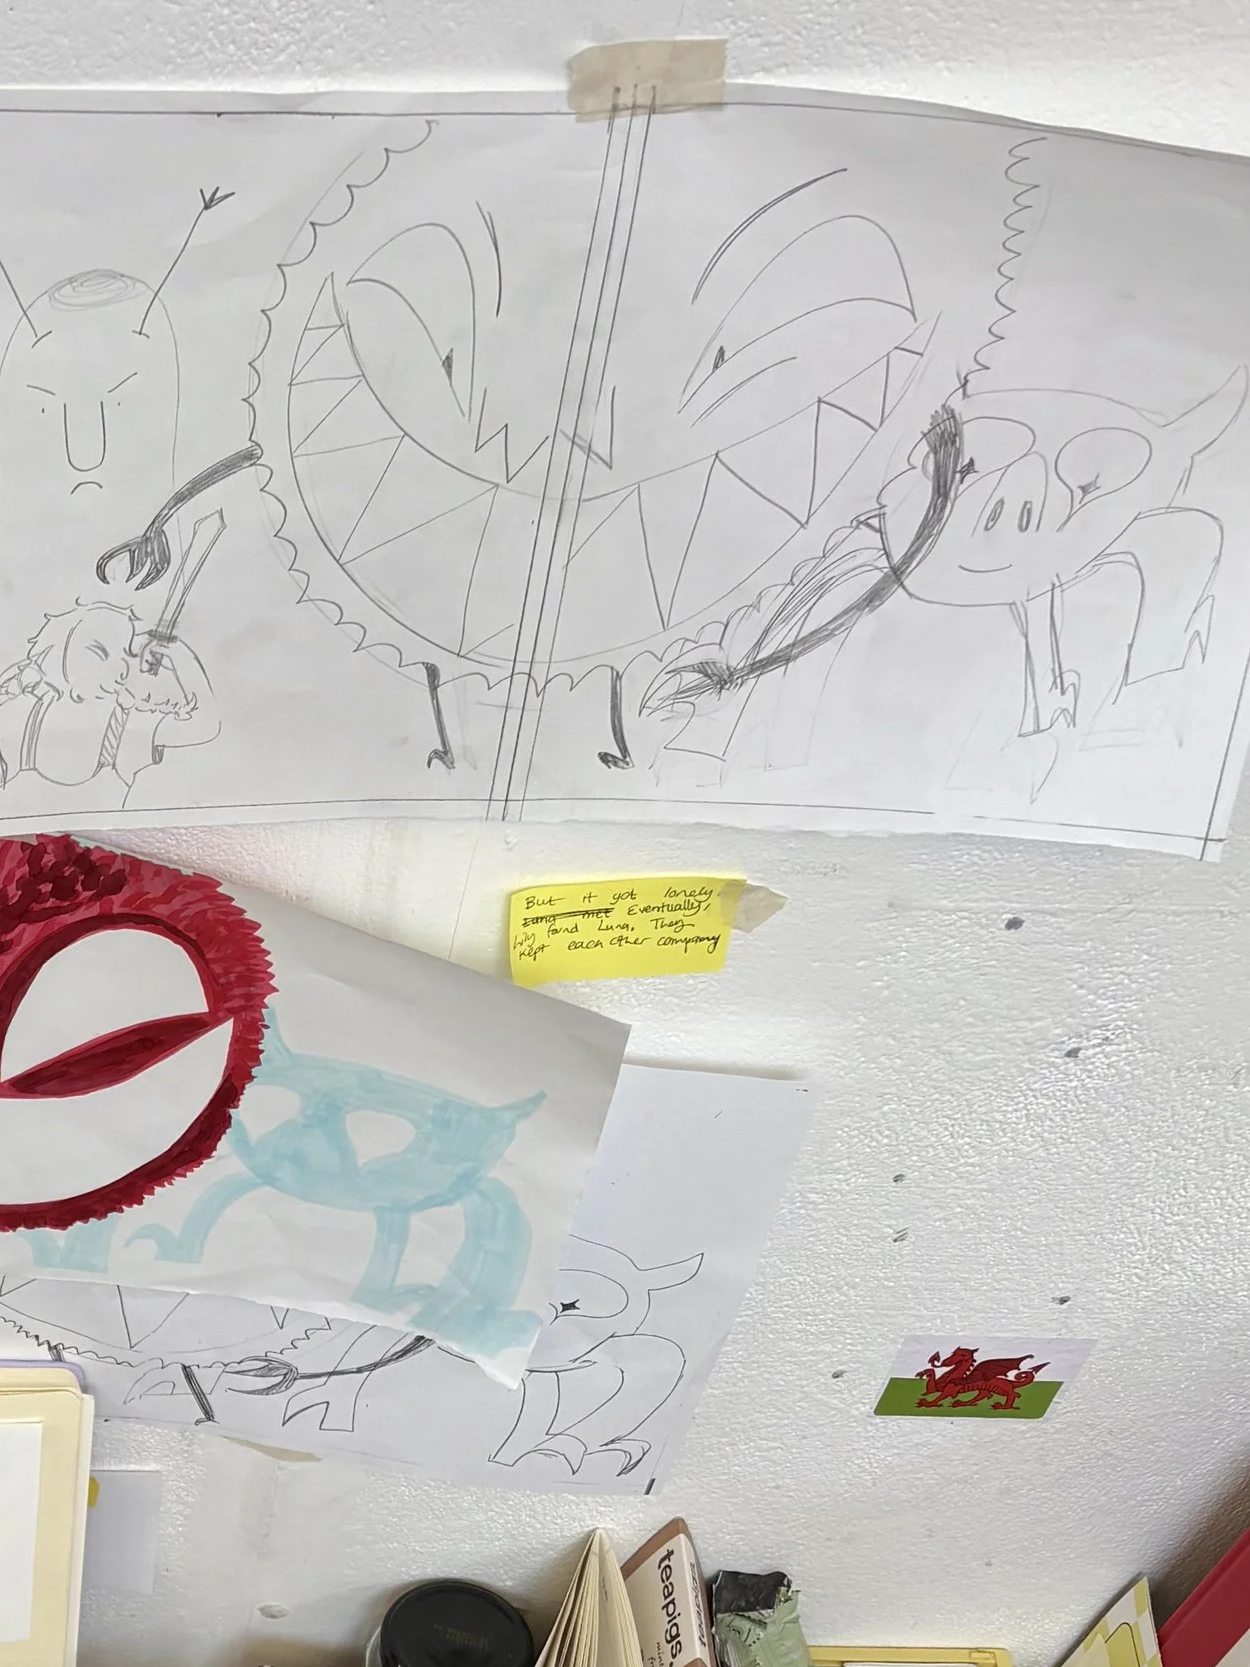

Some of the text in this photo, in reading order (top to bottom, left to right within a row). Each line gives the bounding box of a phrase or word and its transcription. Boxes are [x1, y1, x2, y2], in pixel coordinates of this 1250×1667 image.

[525, 896, 565, 909] But
[582, 892, 598, 903] it
[609, 888, 637, 905] got
[650, 917, 695, 933] They
[567, 939, 603, 951] each
